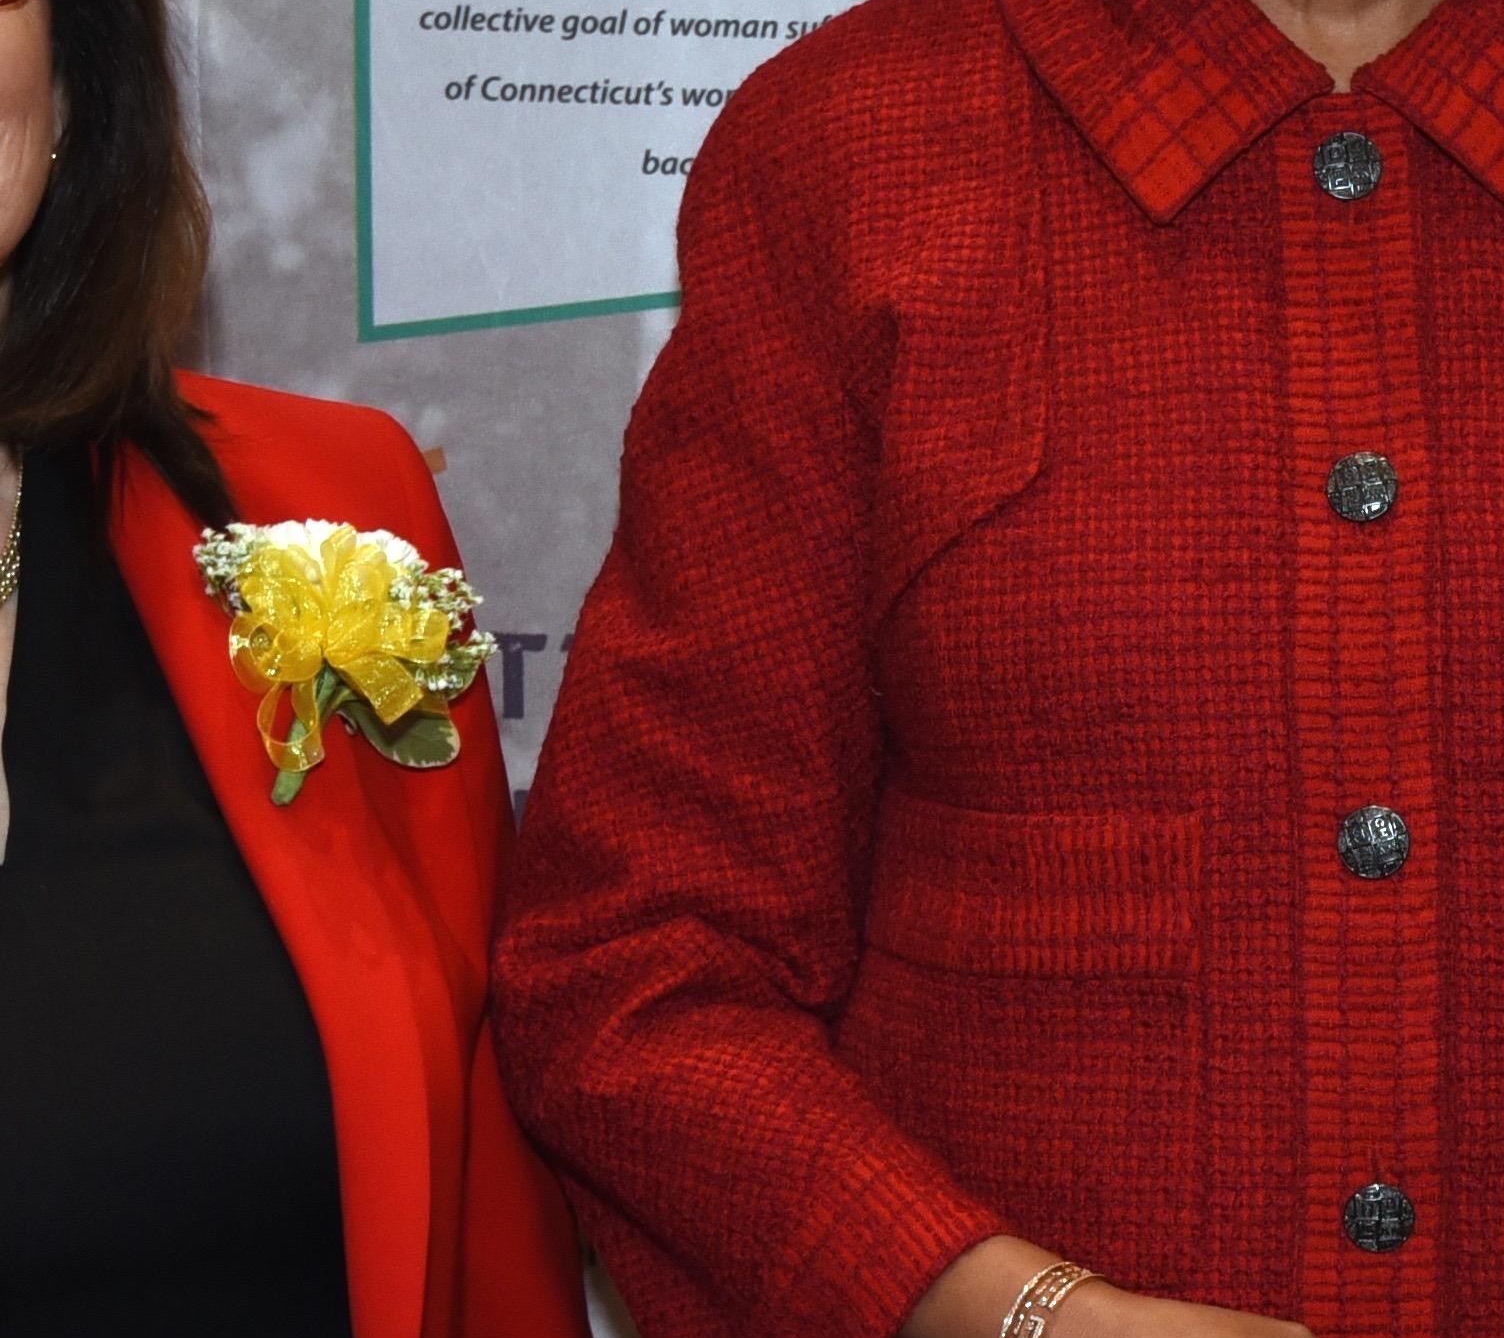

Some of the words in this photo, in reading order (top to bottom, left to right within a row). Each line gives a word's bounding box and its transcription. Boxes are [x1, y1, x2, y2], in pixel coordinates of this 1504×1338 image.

[419, 5, 556, 34] collective
[561, 9, 628, 41] goal
[633, 10, 666, 37] of
[670, 16, 778, 40] woman
[444, 74, 478, 101] of
